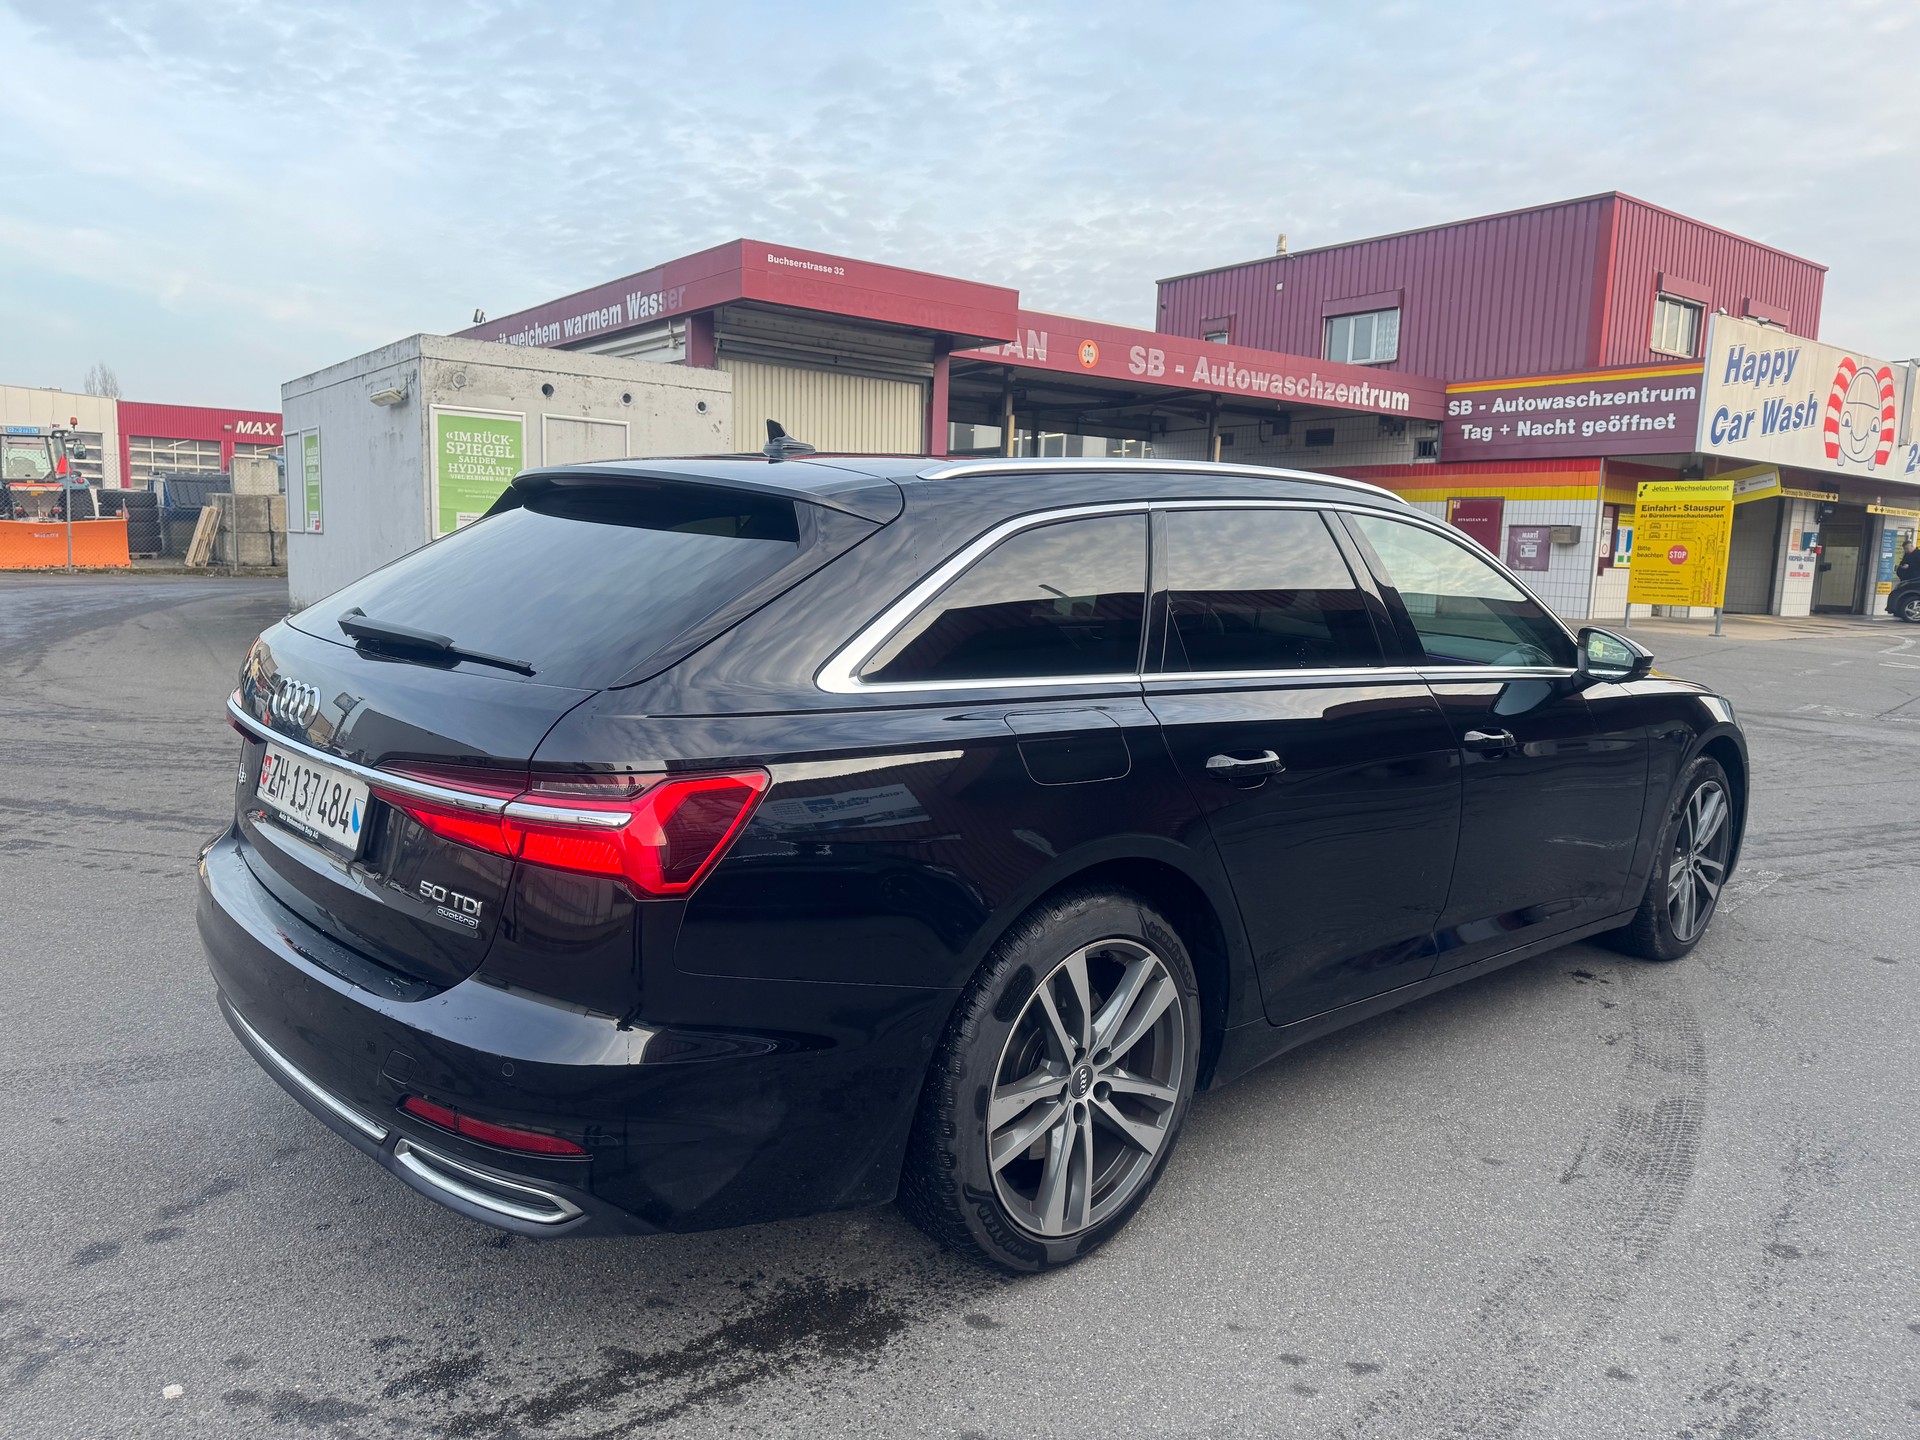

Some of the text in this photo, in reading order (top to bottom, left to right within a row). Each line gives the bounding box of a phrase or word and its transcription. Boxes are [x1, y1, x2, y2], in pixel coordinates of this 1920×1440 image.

[767, 254, 845, 276] Buchserstrasse 32
[509, 322, 560, 347] weichem
[563, 303, 622, 337] warmem
[626, 286, 686, 320] Wasser
[1723, 345, 1801, 388] Happy
[1128, 345, 1410, 411] SB - Autowaschzentrum
[1448, 399, 1473, 416] SB
[1491, 386, 1696, 414] Autowaschzentrum
[235, 420, 277, 436] MAX
[1461, 413, 1676, 442] Tag + Nacht geöffnet
[1710, 393, 1818, 445] Car Wash
[474, 431, 513, 446] RÜCK-
[446, 441, 515, 458] SPIEGEL
[448, 463, 514, 476] HYDRANT
[479, 457, 496, 465] DER
[1674, 484, 1729, 492] Wechselautomat
[1641, 504, 1677, 512] Einfahrt
[1683, 504, 1725, 513] Stauspur
[1669, 550, 1687, 559] STOP
[419, 880, 483, 917] 50 TDI
[437, 908, 475, 926] quattro
